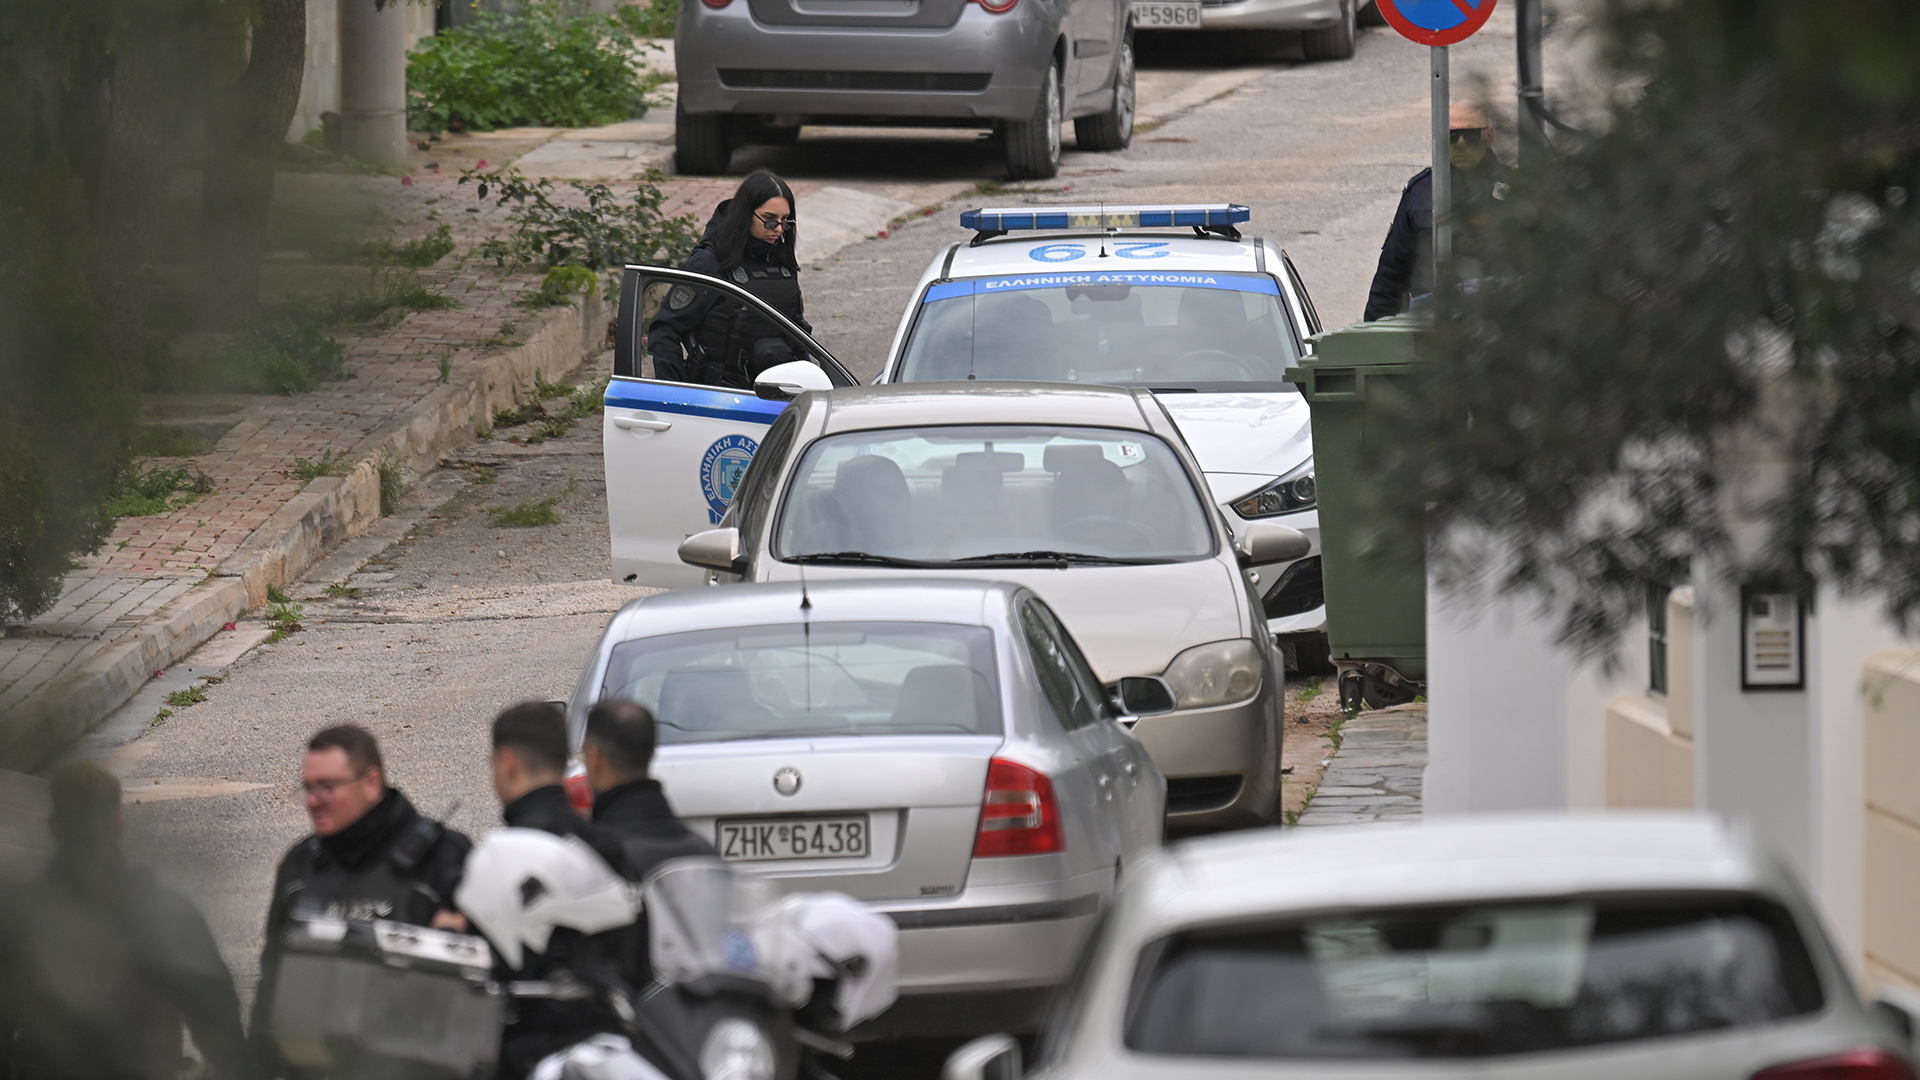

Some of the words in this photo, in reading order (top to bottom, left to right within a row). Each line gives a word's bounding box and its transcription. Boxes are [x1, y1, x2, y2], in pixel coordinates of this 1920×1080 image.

[1151, 7, 1198, 24] 5960
[985, 275, 1091, 289] ΕΛΛΗΝΙΚΗ
[1097, 274, 1218, 285] ΑΣΤΥΝΟΜΙΑ
[702, 437, 732, 501] ΕΛΛΗΝΙΚΗ
[791, 822, 863, 855] 6438
